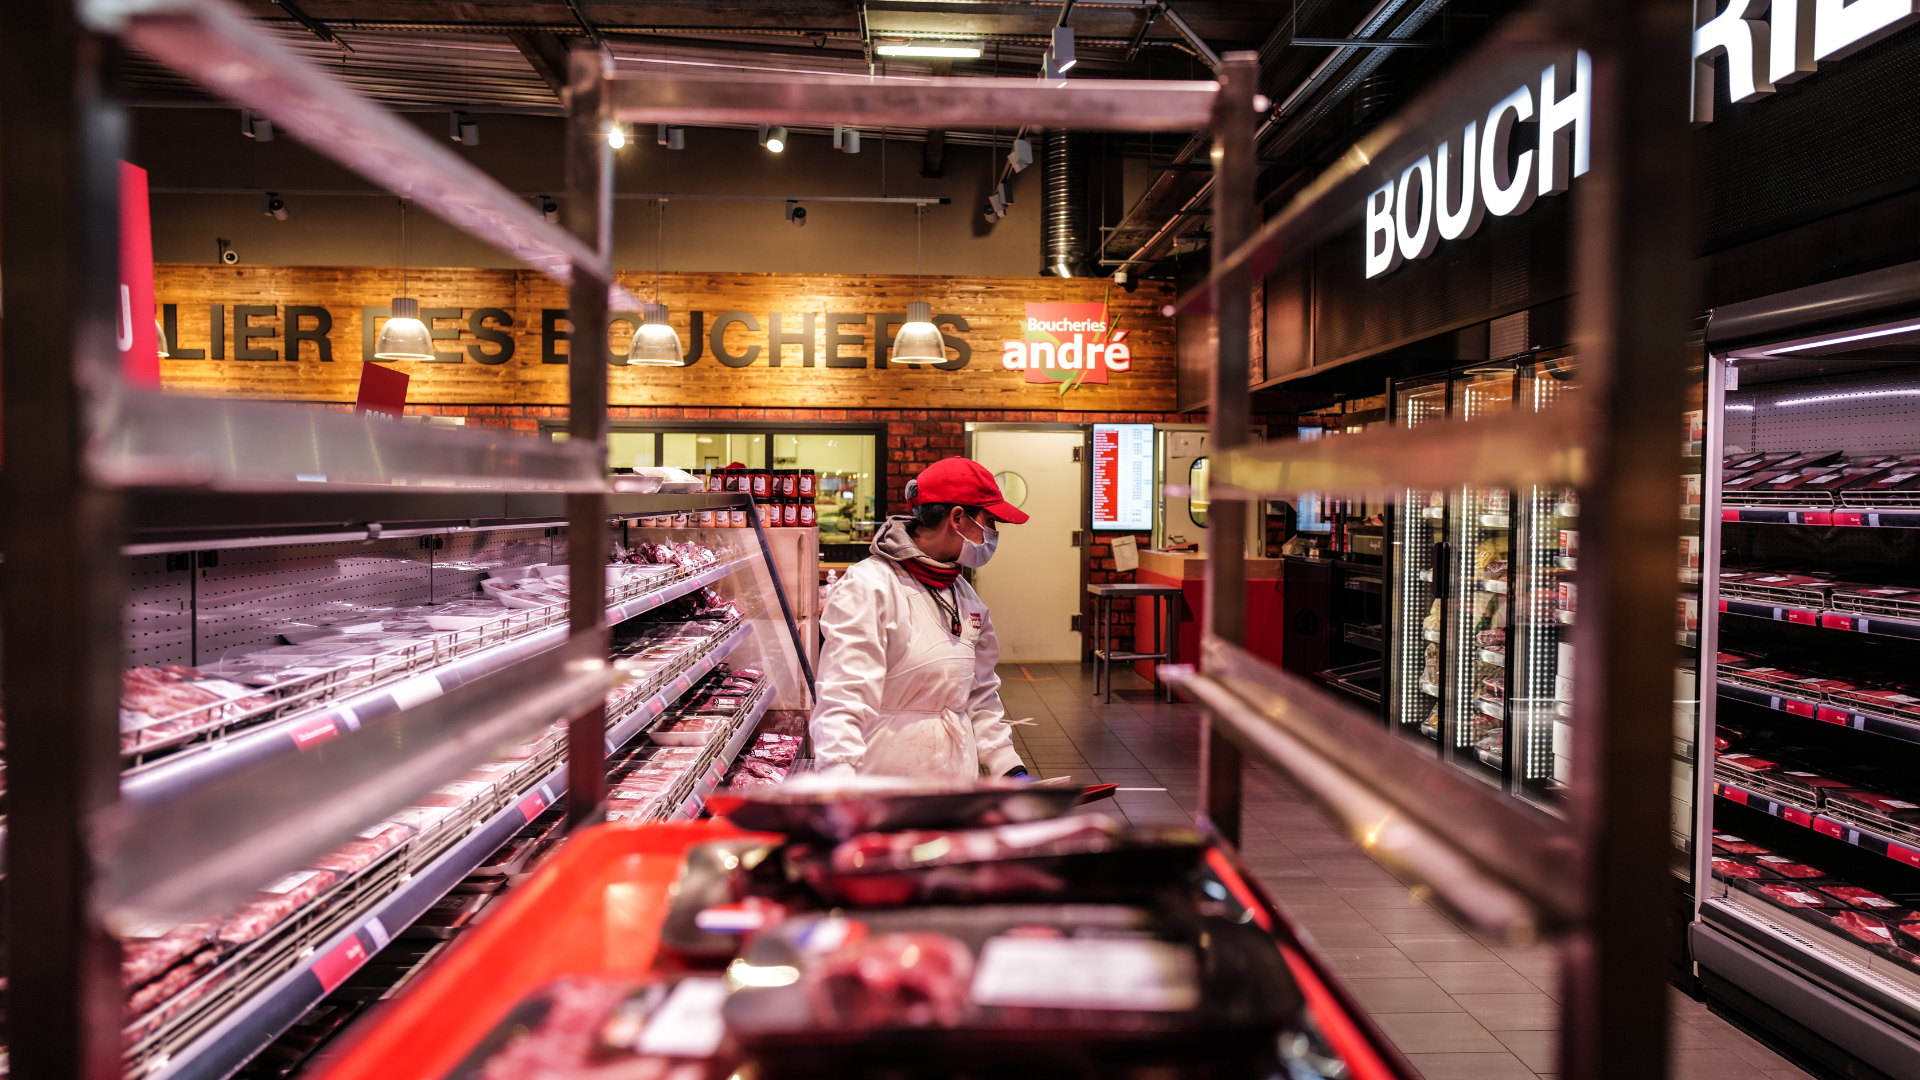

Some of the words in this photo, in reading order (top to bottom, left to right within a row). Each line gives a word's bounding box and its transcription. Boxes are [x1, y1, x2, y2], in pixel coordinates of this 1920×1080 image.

[155, 303, 333, 362] LIER
[362, 306, 515, 365] DES
[1028, 318, 1106, 332] Boucheries
[1002, 331, 1130, 370] andré
